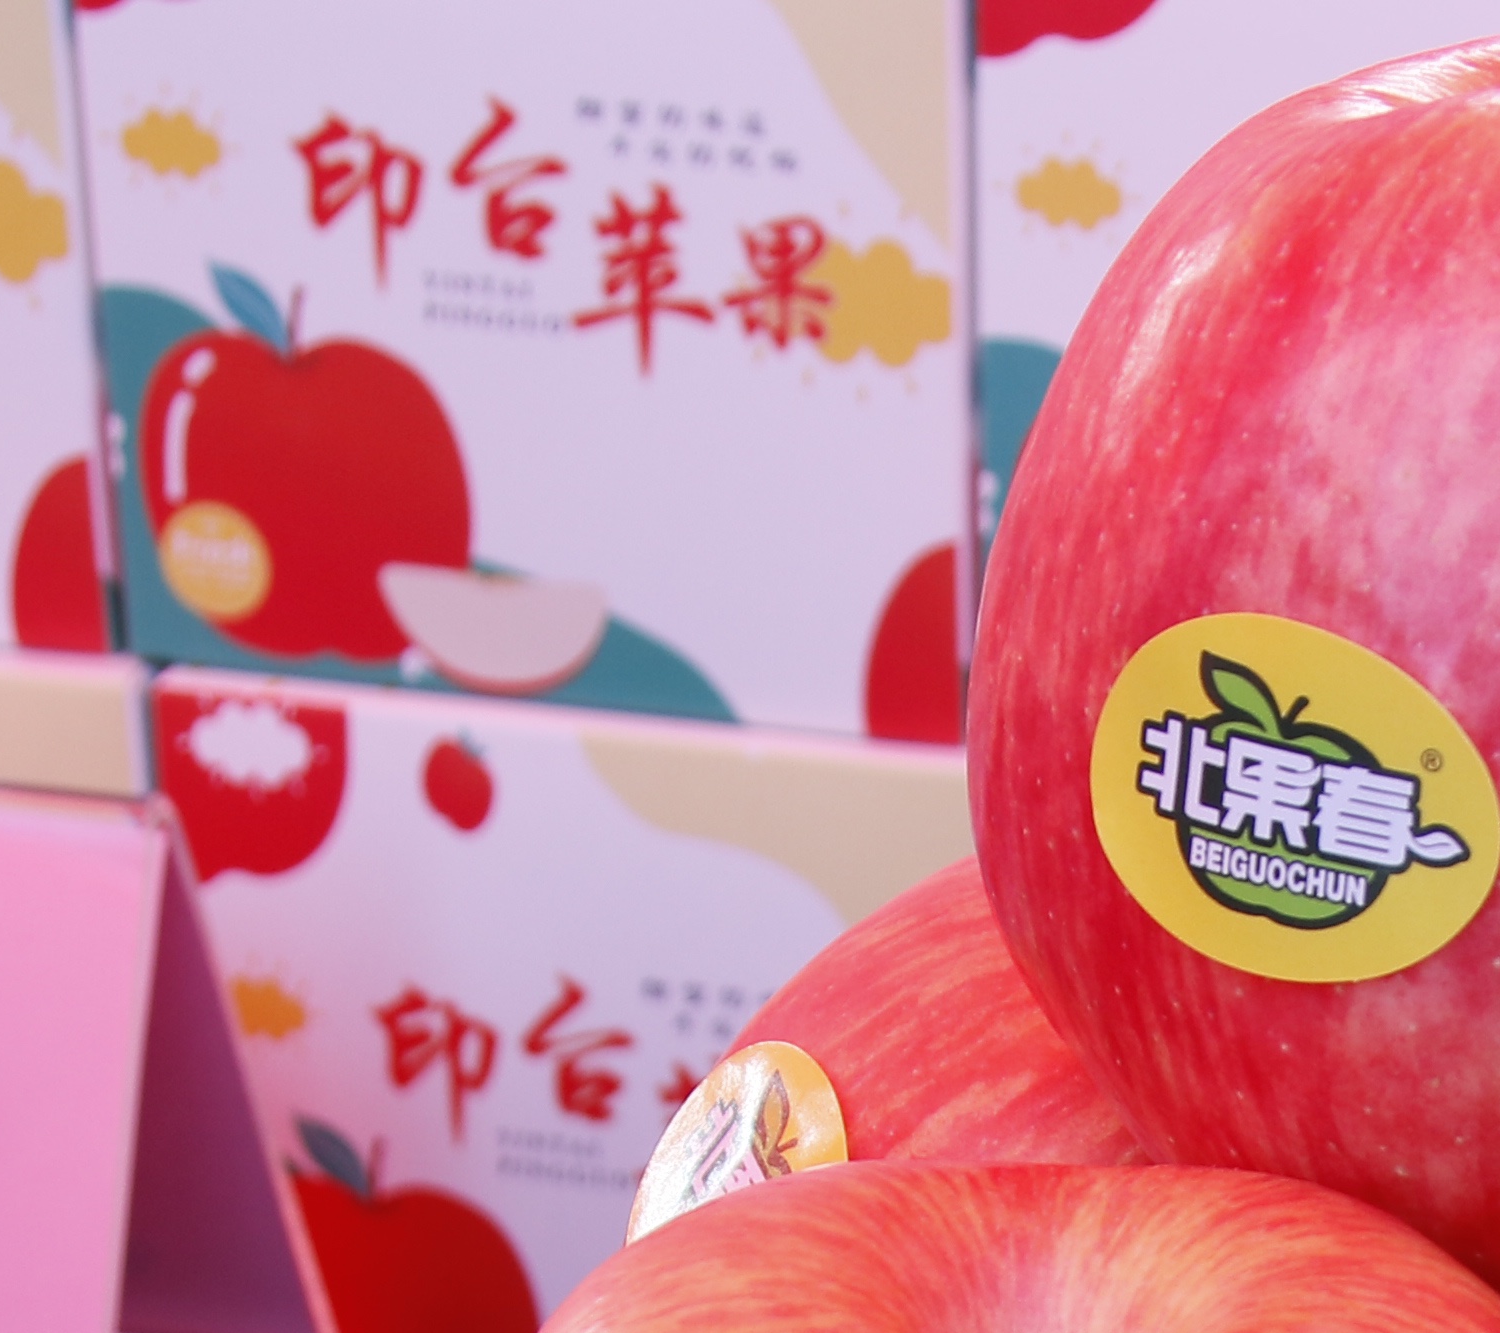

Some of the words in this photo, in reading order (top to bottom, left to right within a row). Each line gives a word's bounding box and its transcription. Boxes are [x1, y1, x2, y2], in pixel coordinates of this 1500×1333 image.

[293, 98, 833, 379] 印台苹果
[1138, 716, 1466, 868] 北果春
[1187, 835, 1368, 908] BEIGUOCHUN
